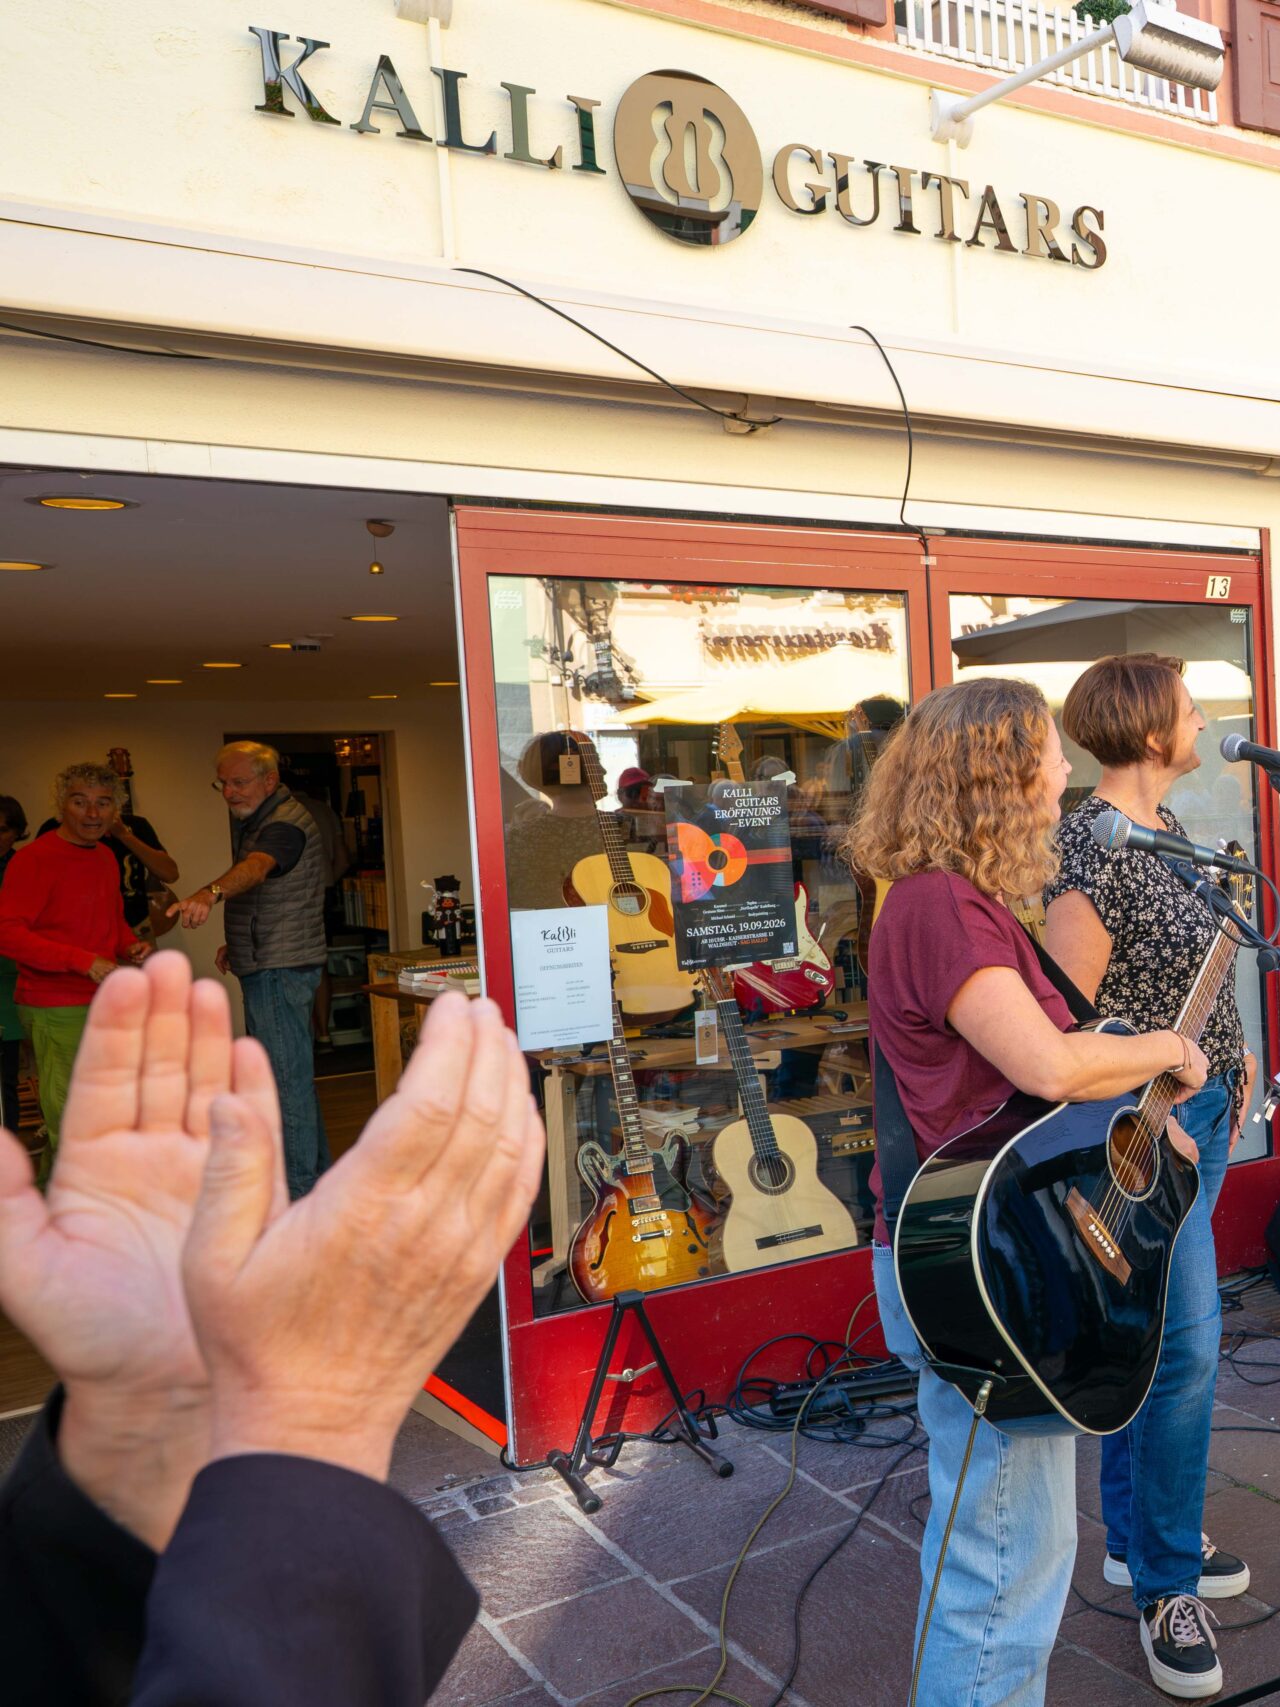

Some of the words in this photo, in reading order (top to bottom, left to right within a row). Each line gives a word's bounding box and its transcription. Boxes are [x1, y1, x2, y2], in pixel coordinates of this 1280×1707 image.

[248, 26, 607, 175] KALLI
[772, 143, 1108, 272] GUITARS
[1210, 578, 1229, 597] 13
[723, 788, 752, 798] KALLI
[735, 797, 779, 808] GUITARS
[714, 806, 781, 819] ERÖFFNUNGS
[686, 924, 737, 937] SAMSTAG,
[739, 918, 786, 932] 19.09.2026
